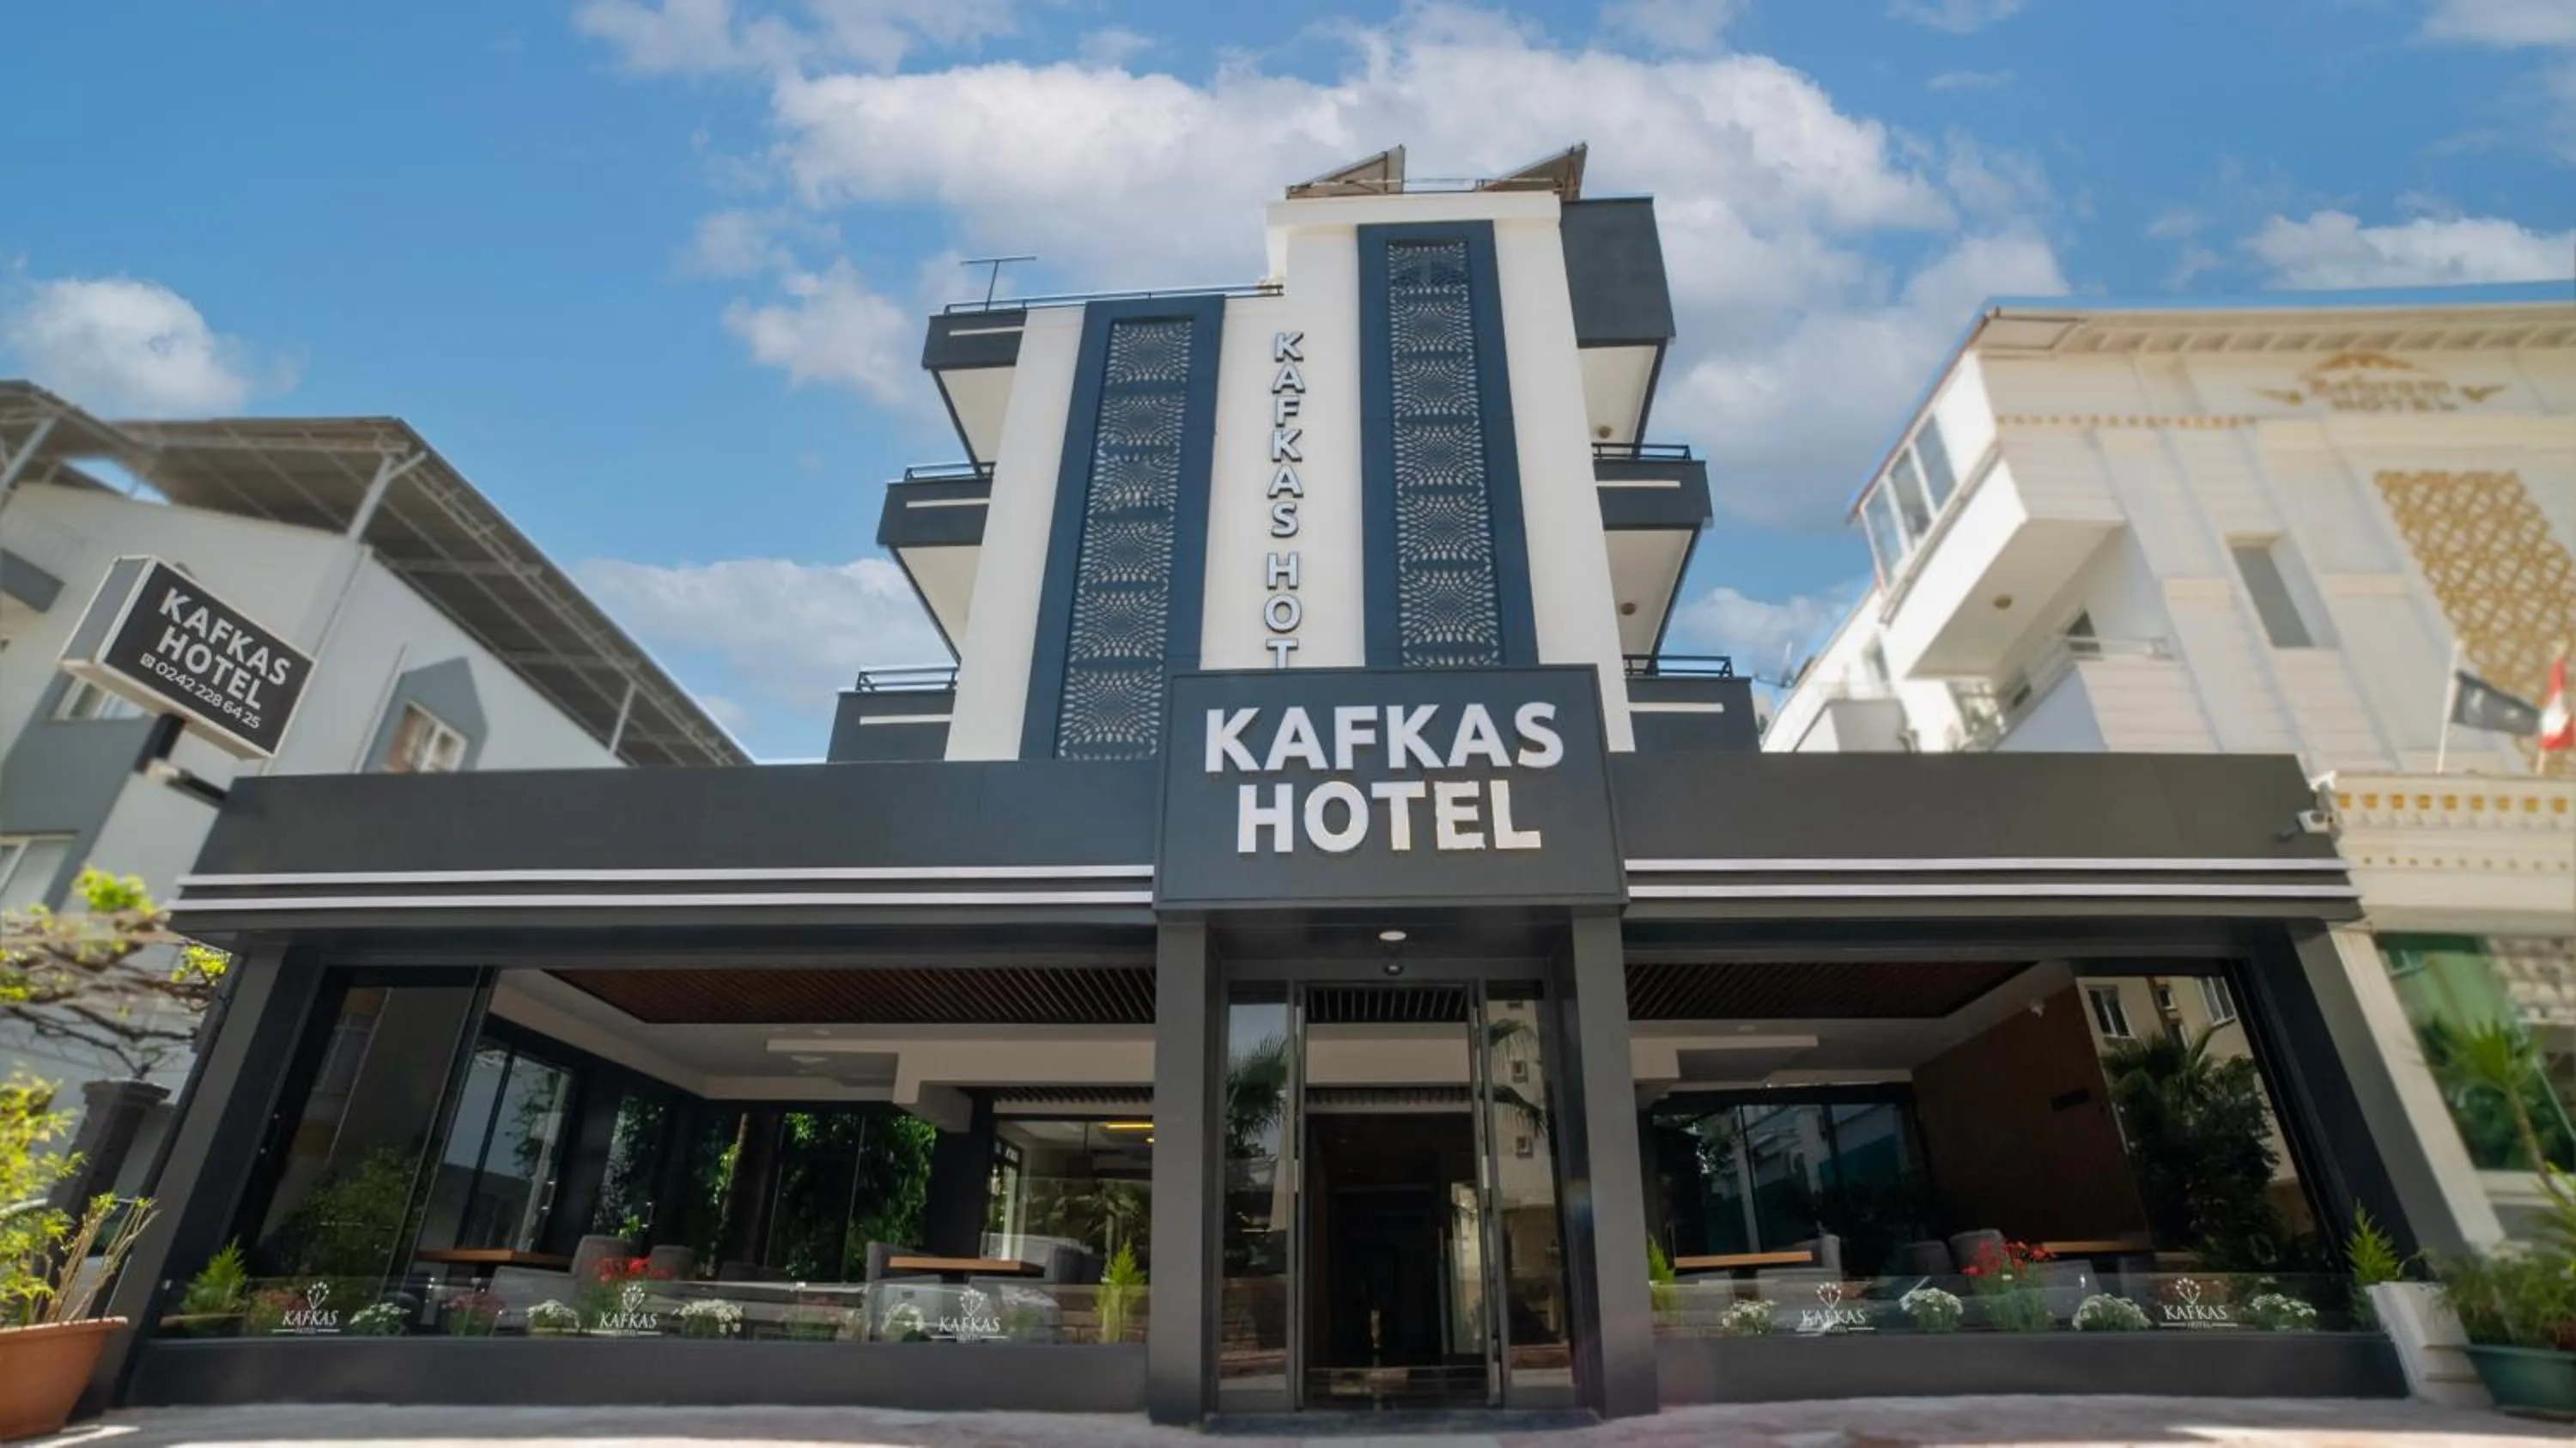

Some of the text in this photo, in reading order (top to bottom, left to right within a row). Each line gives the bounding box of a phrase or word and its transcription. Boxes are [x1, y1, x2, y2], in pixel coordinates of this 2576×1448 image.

[1267, 331, 1305, 538] KAFKAS
[156, 624, 261, 710] HOTEL
[158, 586, 292, 686] KAFKAS
[155, 661, 261, 729] 0242 228 64 25
[1205, 702, 1564, 773] KAFKAS
[1236, 779, 1542, 854] HOTEL
[282, 1310, 340, 1326] KAFKAS
[599, 1311, 659, 1329] KAFKAS
[939, 1316, 1001, 1332] KAFKAS
[2164, 1305, 2227, 1320] KAFKAS
